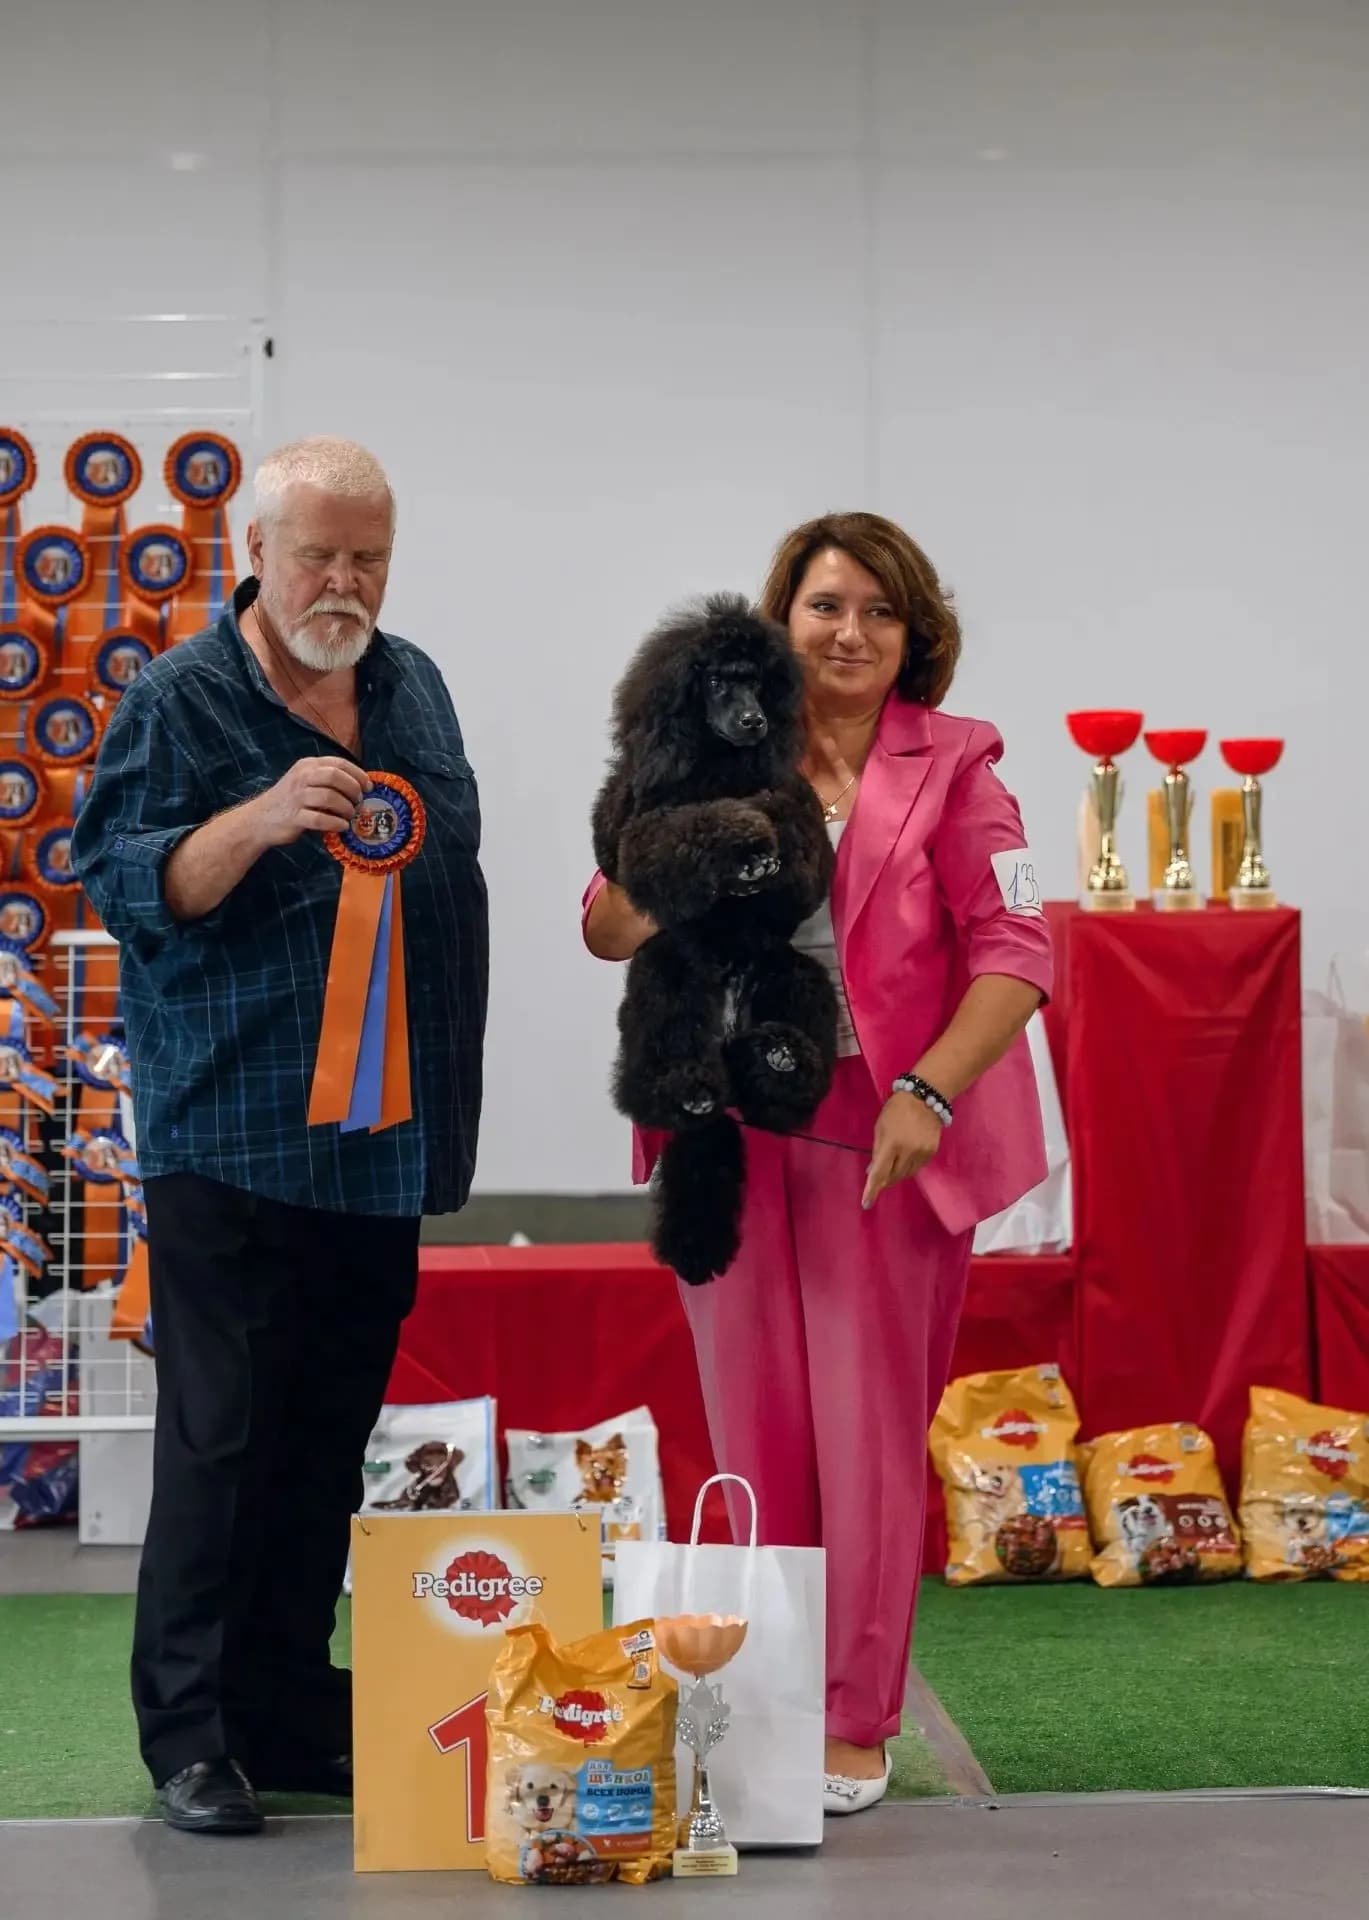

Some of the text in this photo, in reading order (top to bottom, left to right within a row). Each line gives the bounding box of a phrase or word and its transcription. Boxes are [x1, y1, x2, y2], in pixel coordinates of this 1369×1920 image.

[412, 1572, 544, 1602] Pedigree
[538, 1695, 624, 1728] Pedigree
[428, 1690, 488, 1843] 1
